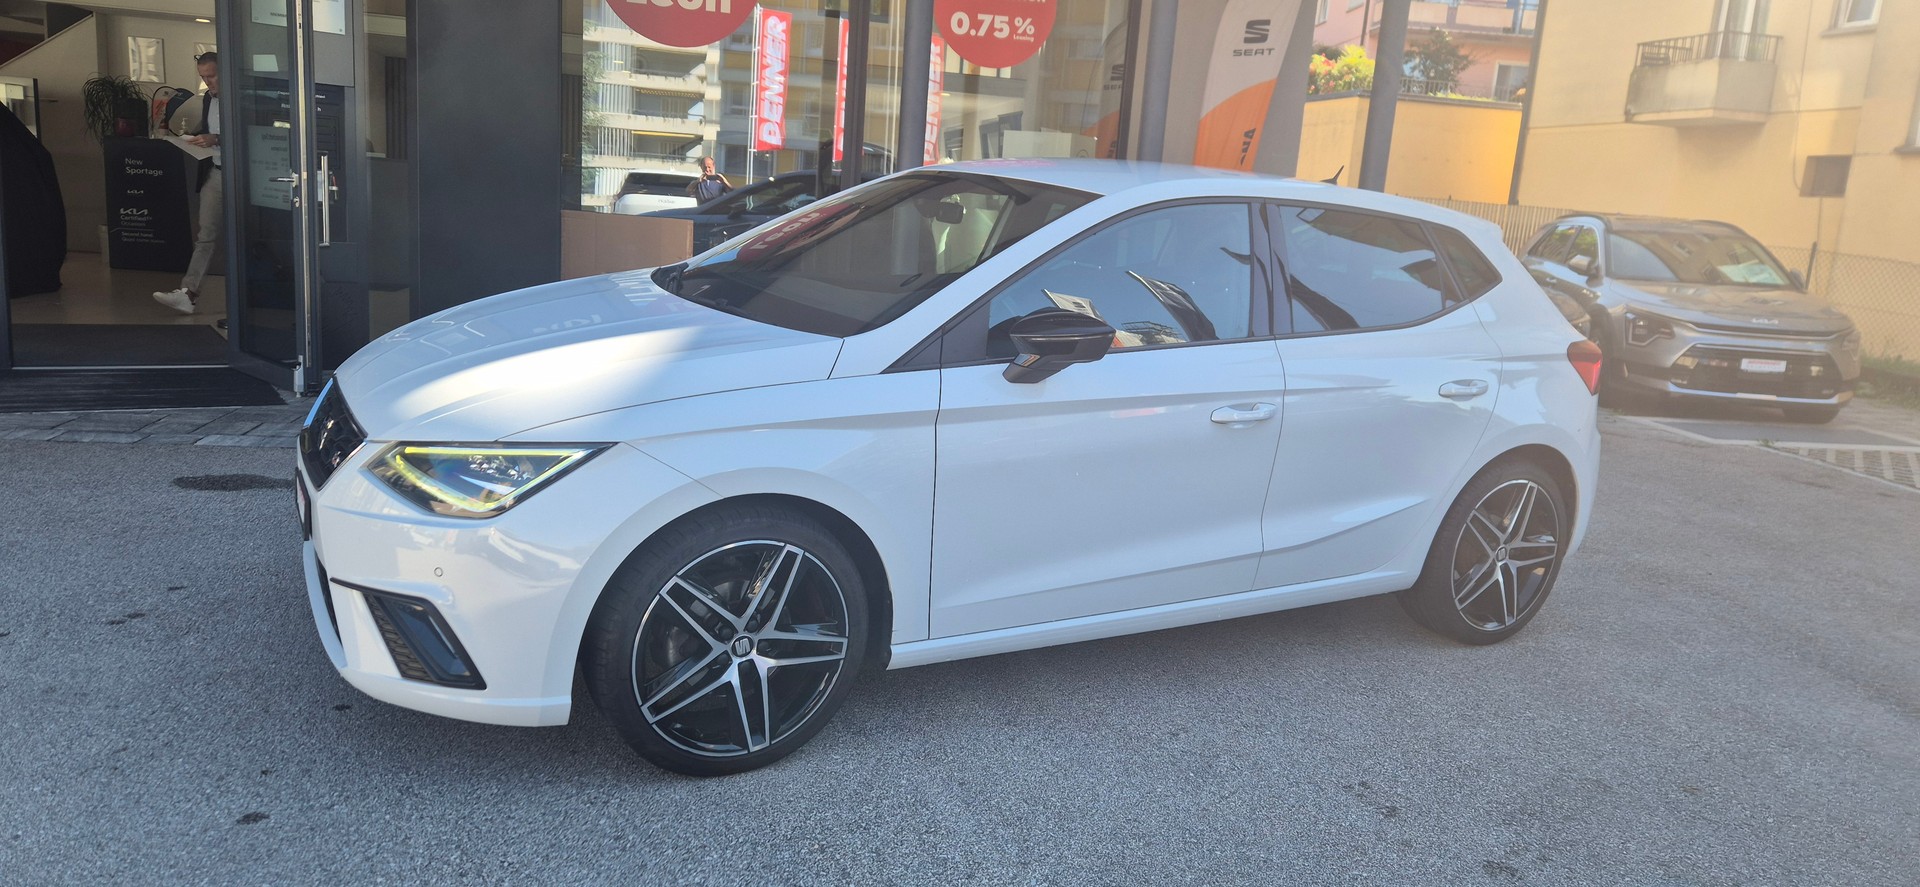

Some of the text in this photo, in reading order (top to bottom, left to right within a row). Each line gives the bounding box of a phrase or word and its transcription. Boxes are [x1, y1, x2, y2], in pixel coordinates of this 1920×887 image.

[950, 11, 1035, 39] 0.75 %
[1232, 48, 1275, 57] SEAT
[761, 15, 787, 146] DENNER
[125, 166, 163, 177] Sportage
